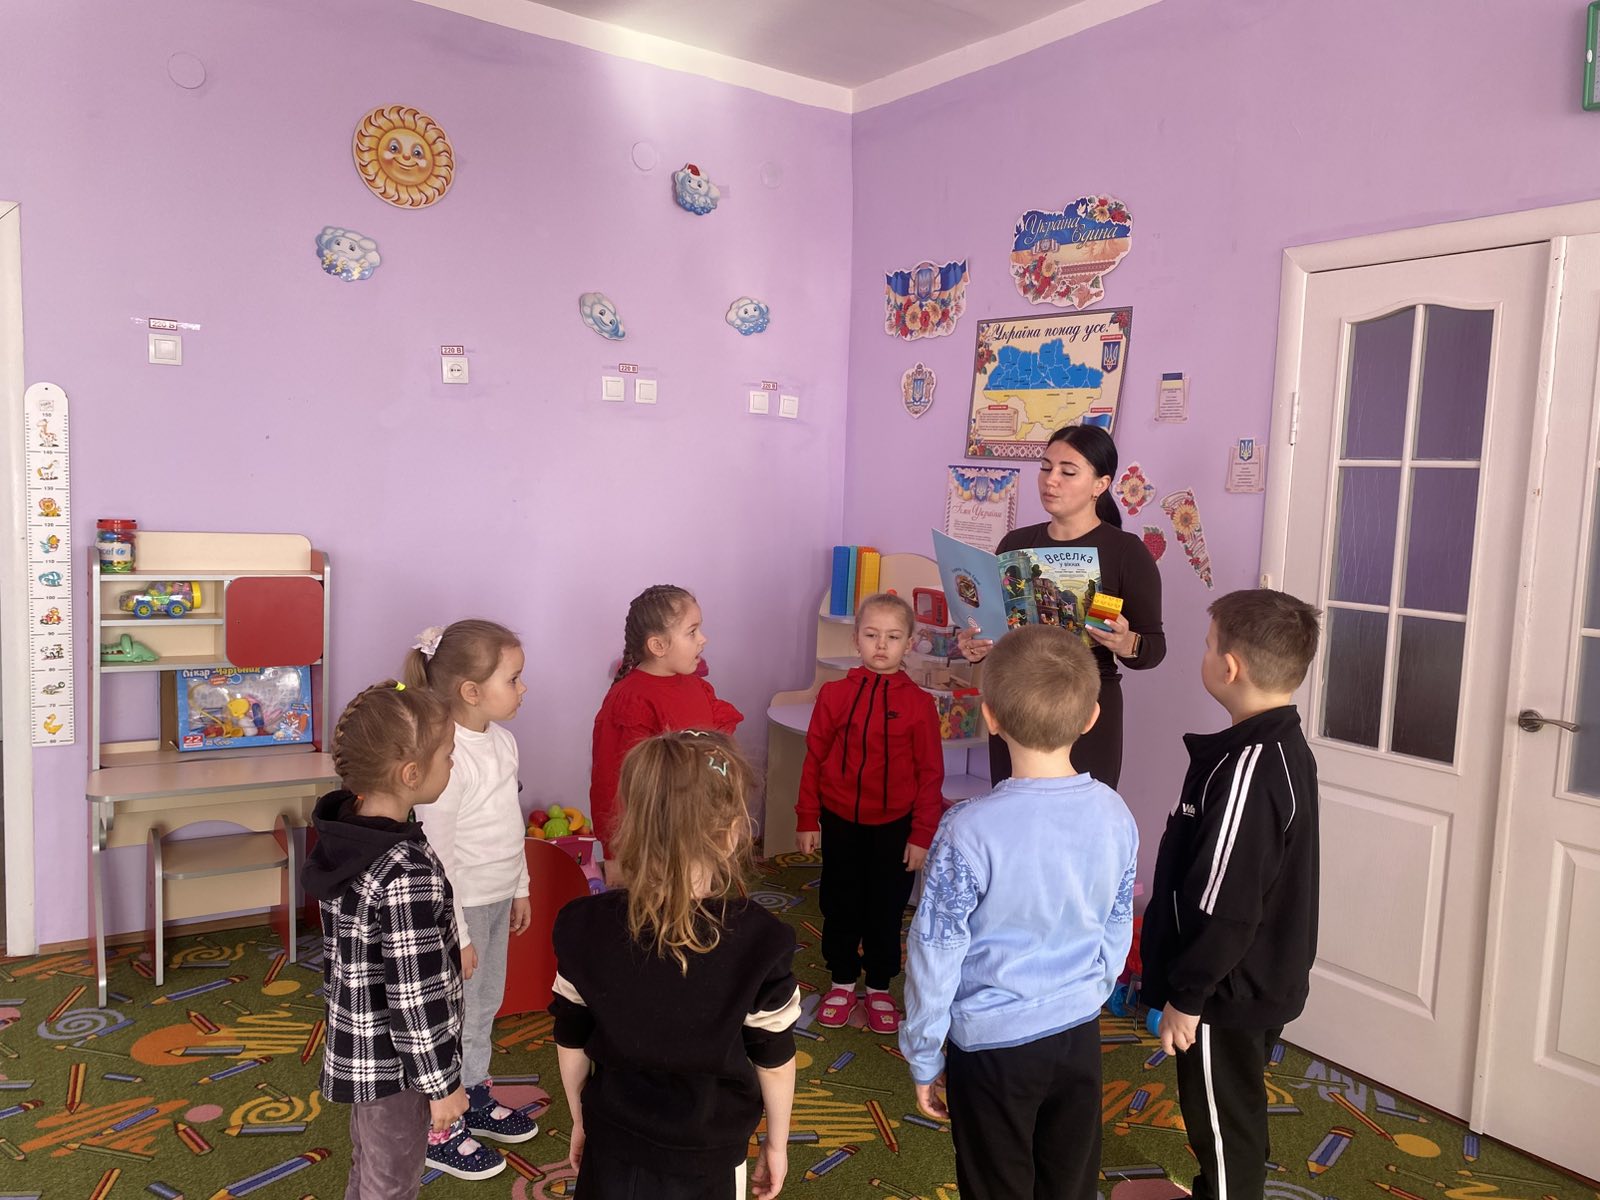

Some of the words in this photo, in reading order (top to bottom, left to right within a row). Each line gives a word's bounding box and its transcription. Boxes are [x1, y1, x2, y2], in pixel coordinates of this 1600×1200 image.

[1024, 214, 1080, 244] Україна
[1072, 223, 1118, 249] Єдина
[991, 323, 1041, 344] Україна
[1044, 324, 1081, 343] понад
[1044, 552, 1093, 564] Веселка
[185, 735, 201, 743] 22
